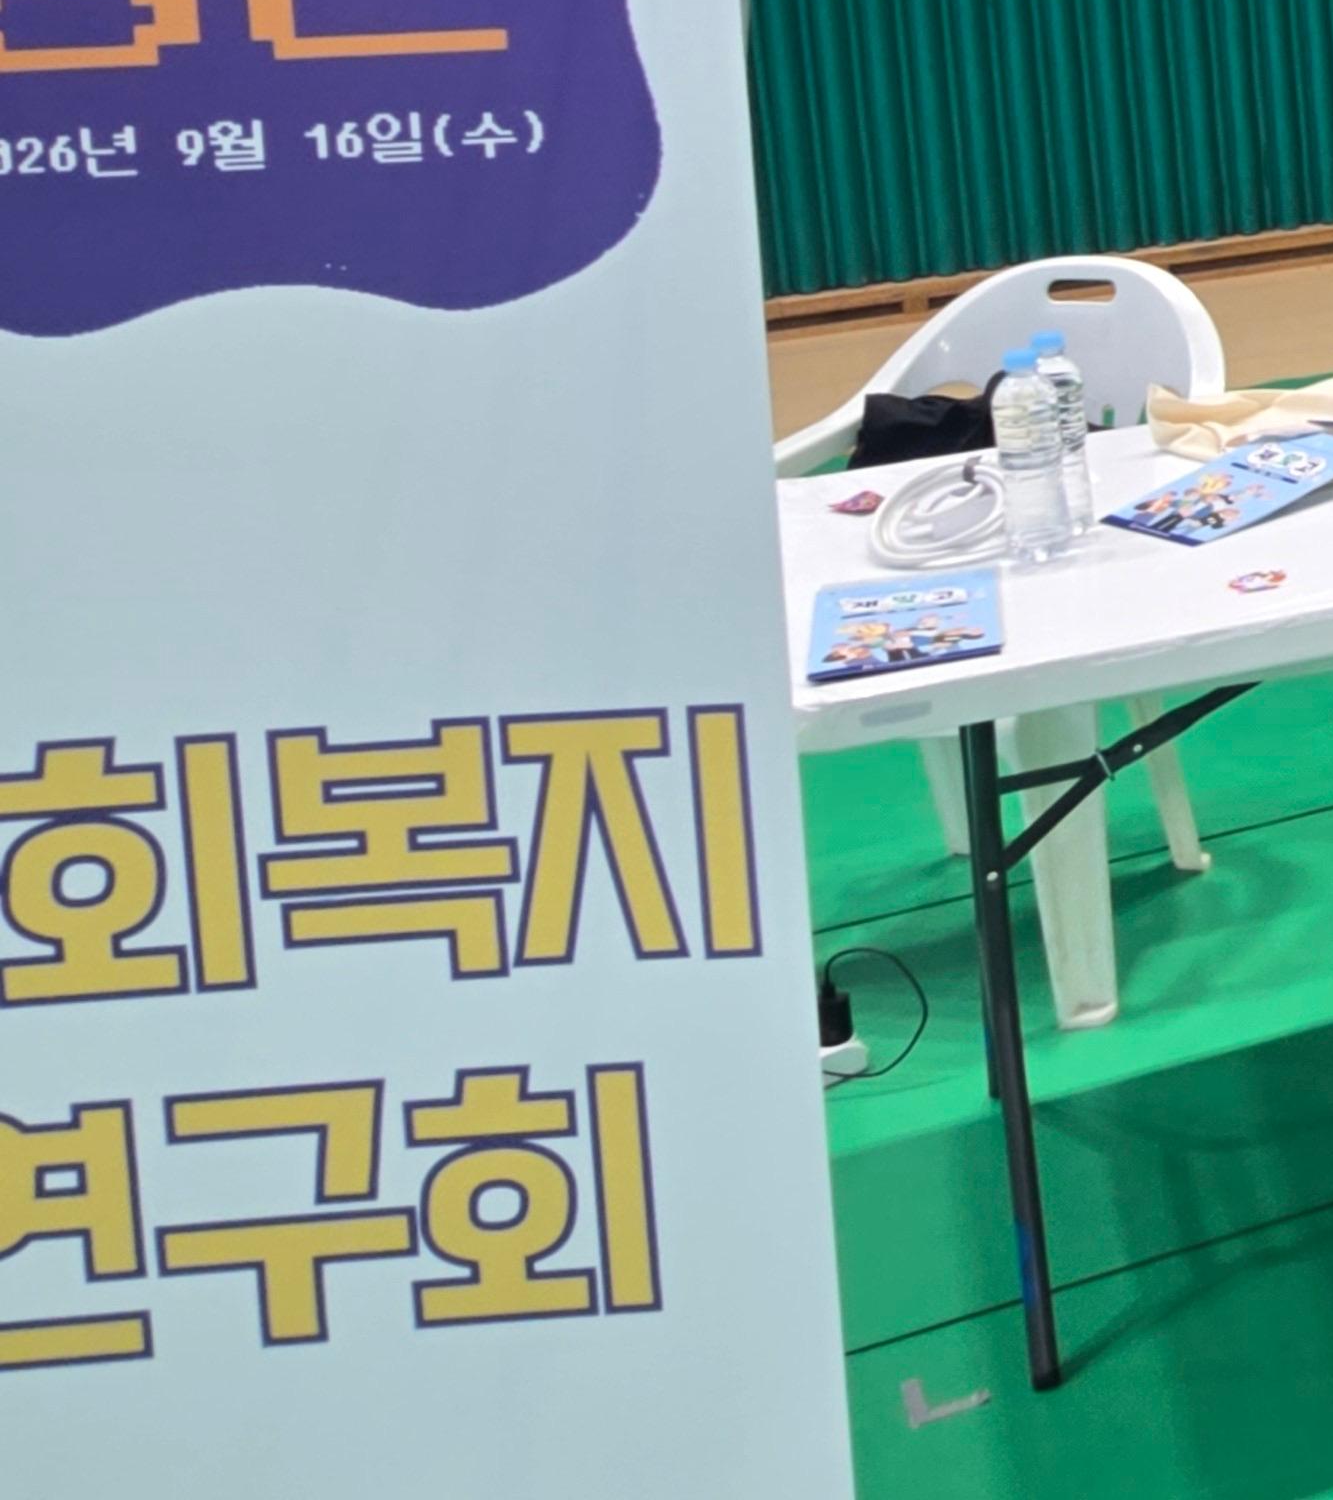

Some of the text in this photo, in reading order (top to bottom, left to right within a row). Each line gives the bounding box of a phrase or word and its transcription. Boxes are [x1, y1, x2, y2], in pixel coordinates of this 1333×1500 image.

[176, 118, 266, 172] 9월
[304, 110, 545, 164] 16일(수)
[0, 703, 763, 1009] 회복지
